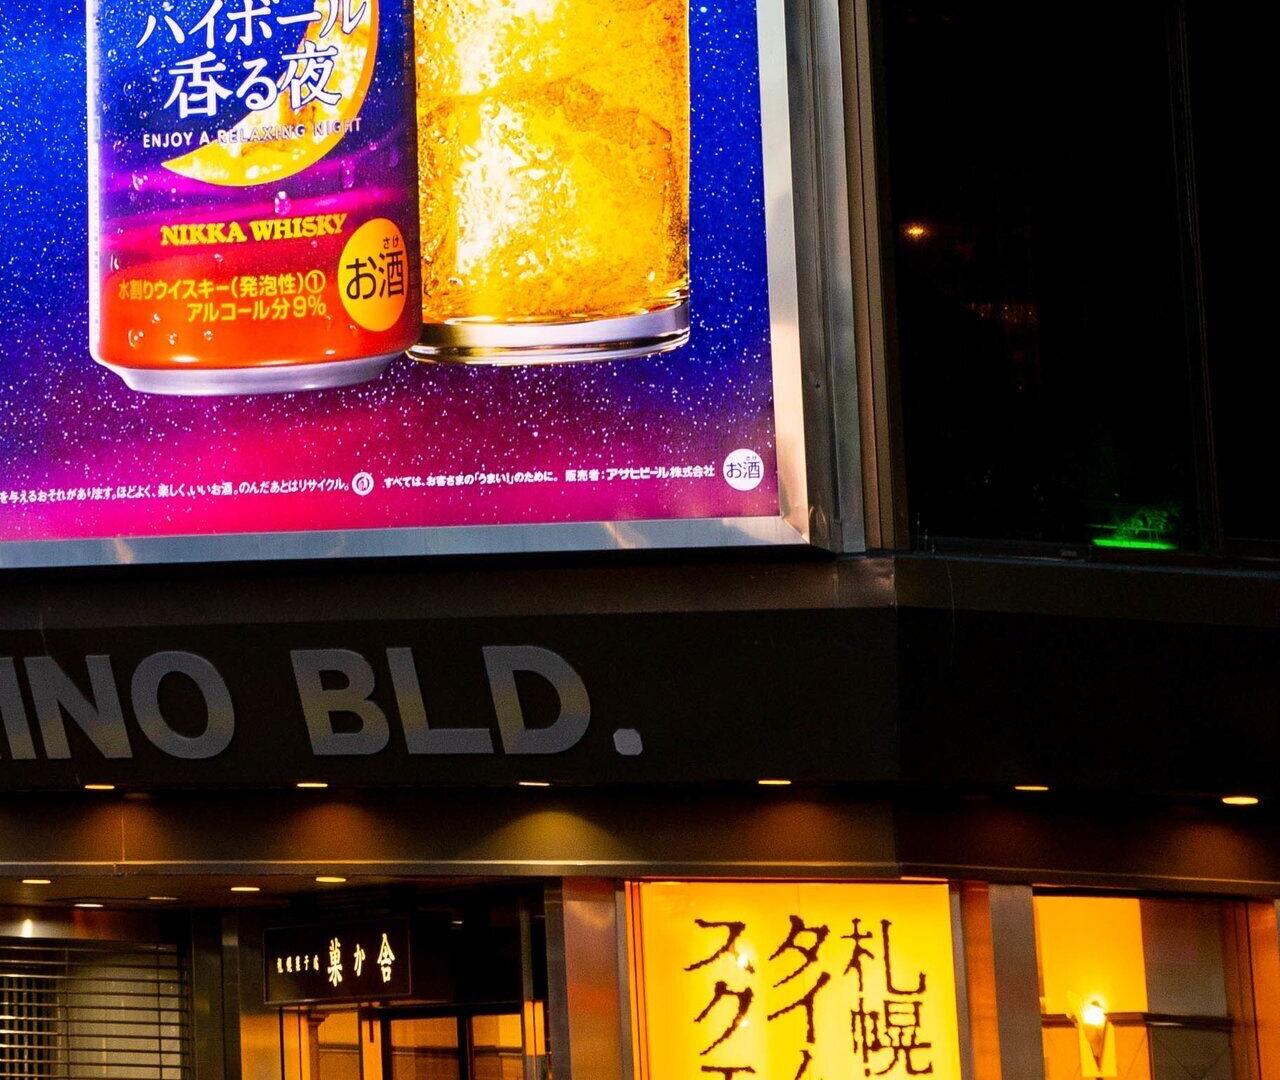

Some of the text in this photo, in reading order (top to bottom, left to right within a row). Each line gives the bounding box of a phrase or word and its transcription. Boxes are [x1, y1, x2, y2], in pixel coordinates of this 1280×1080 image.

[164, 41, 342, 119] 香る夜
[143, 117, 363, 149] ENJOY A RELAXING NIGHT
[160, 213, 348, 246] NIKKA WHISKY
[383, 235, 400, 249] さけ
[346, 252, 406, 300] お酒
[188, 296, 327, 324] アルコール分9%
[726, 461, 761, 481] お酒
[289, 644, 644, 757] BLD.
[327, 933, 395, 987] 菓か舎
[840, 918, 933, 1077] 札幌
